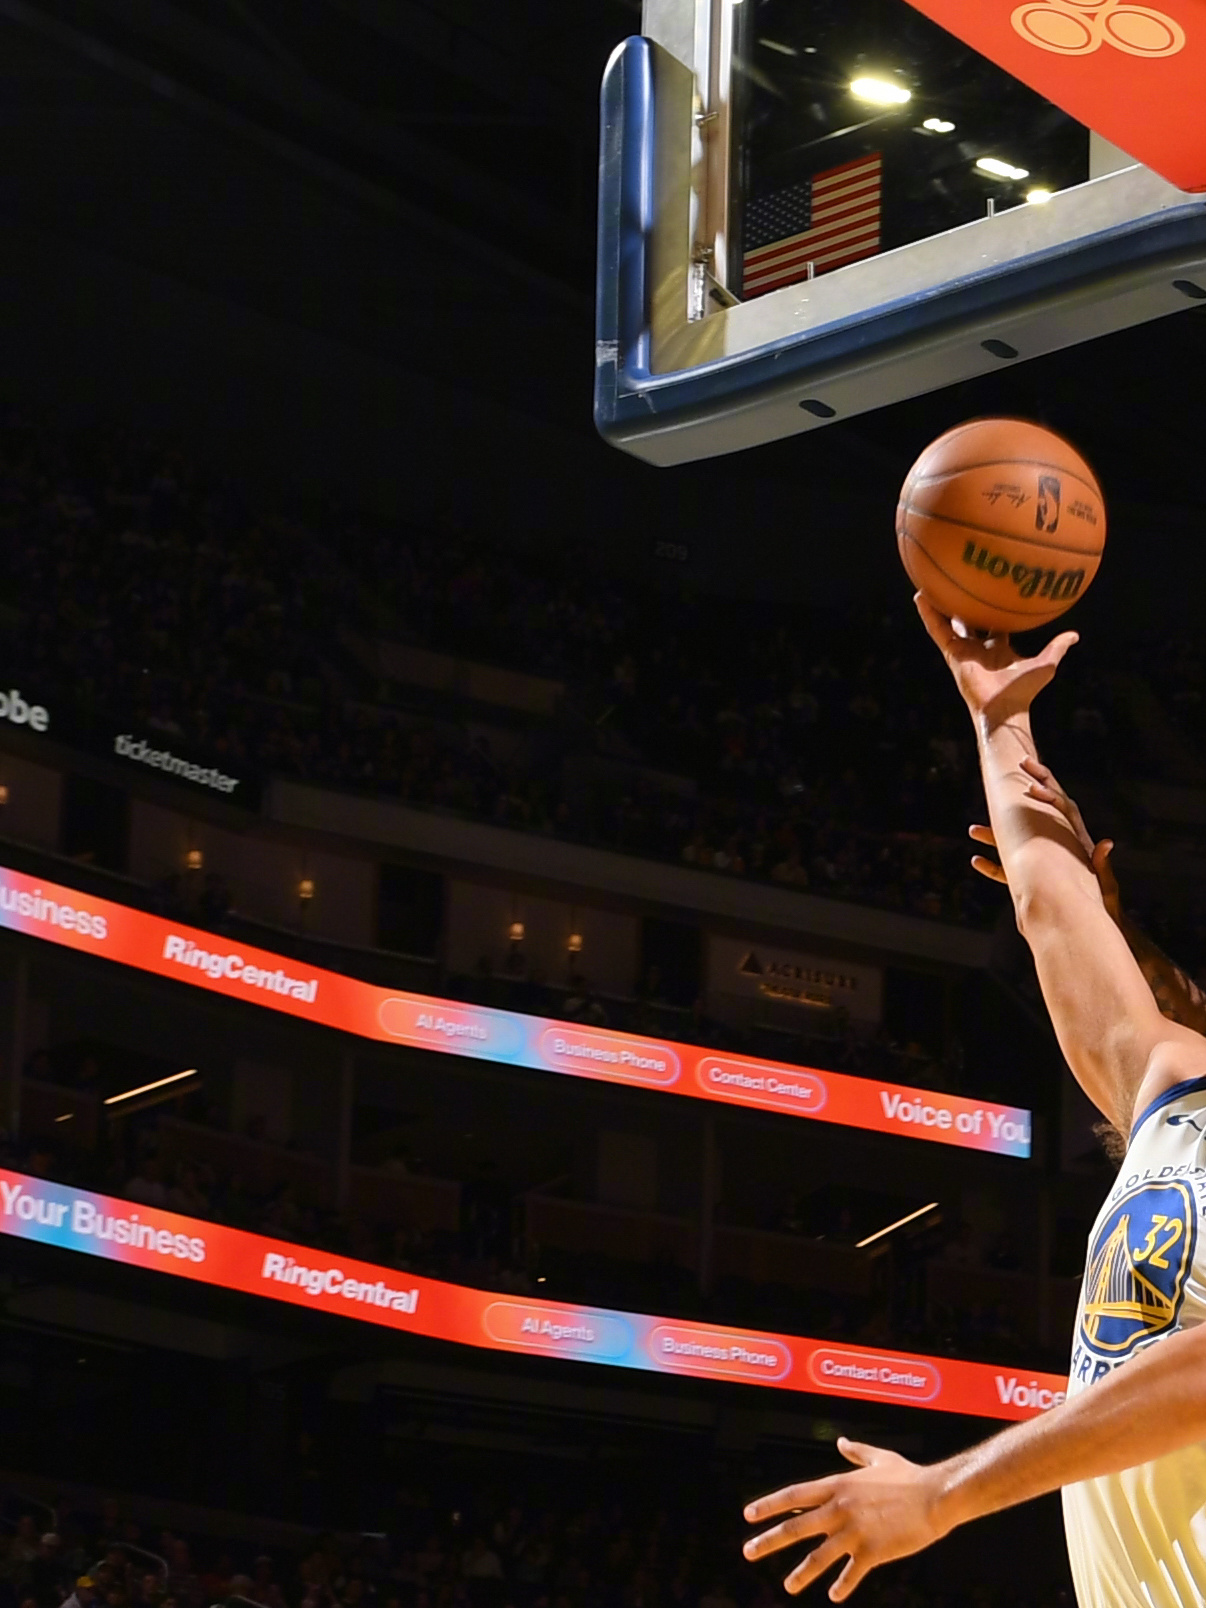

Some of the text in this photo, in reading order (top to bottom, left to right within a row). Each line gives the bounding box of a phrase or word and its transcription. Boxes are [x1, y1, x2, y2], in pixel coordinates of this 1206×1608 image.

[962, 540, 1086, 601] Wilson
[113, 734, 240, 794] ticketmaster
[0, 886, 108, 940] usiness
[162, 934, 319, 1004] RingCentral
[435, 1016, 488, 1041] Agents
[555, 1038, 667, 1073] Business Phone
[708, 1066, 813, 1100] Contact Center
[879, 1090, 953, 1130] Voice
[955, 1109, 986, 1135] of
[1112, 1165, 1188, 1202] GOLDE
[0, 1180, 207, 1264] Your Business
[1133, 1214, 1184, 1270] 32
[261, 1252, 419, 1315] RingCentral
[540, 1319, 595, 1342] Agents
[661, 1336, 778, 1367] Business Phone
[820, 1358, 927, 1389] Contact Center
[994, 1374, 1068, 1411] Voice
